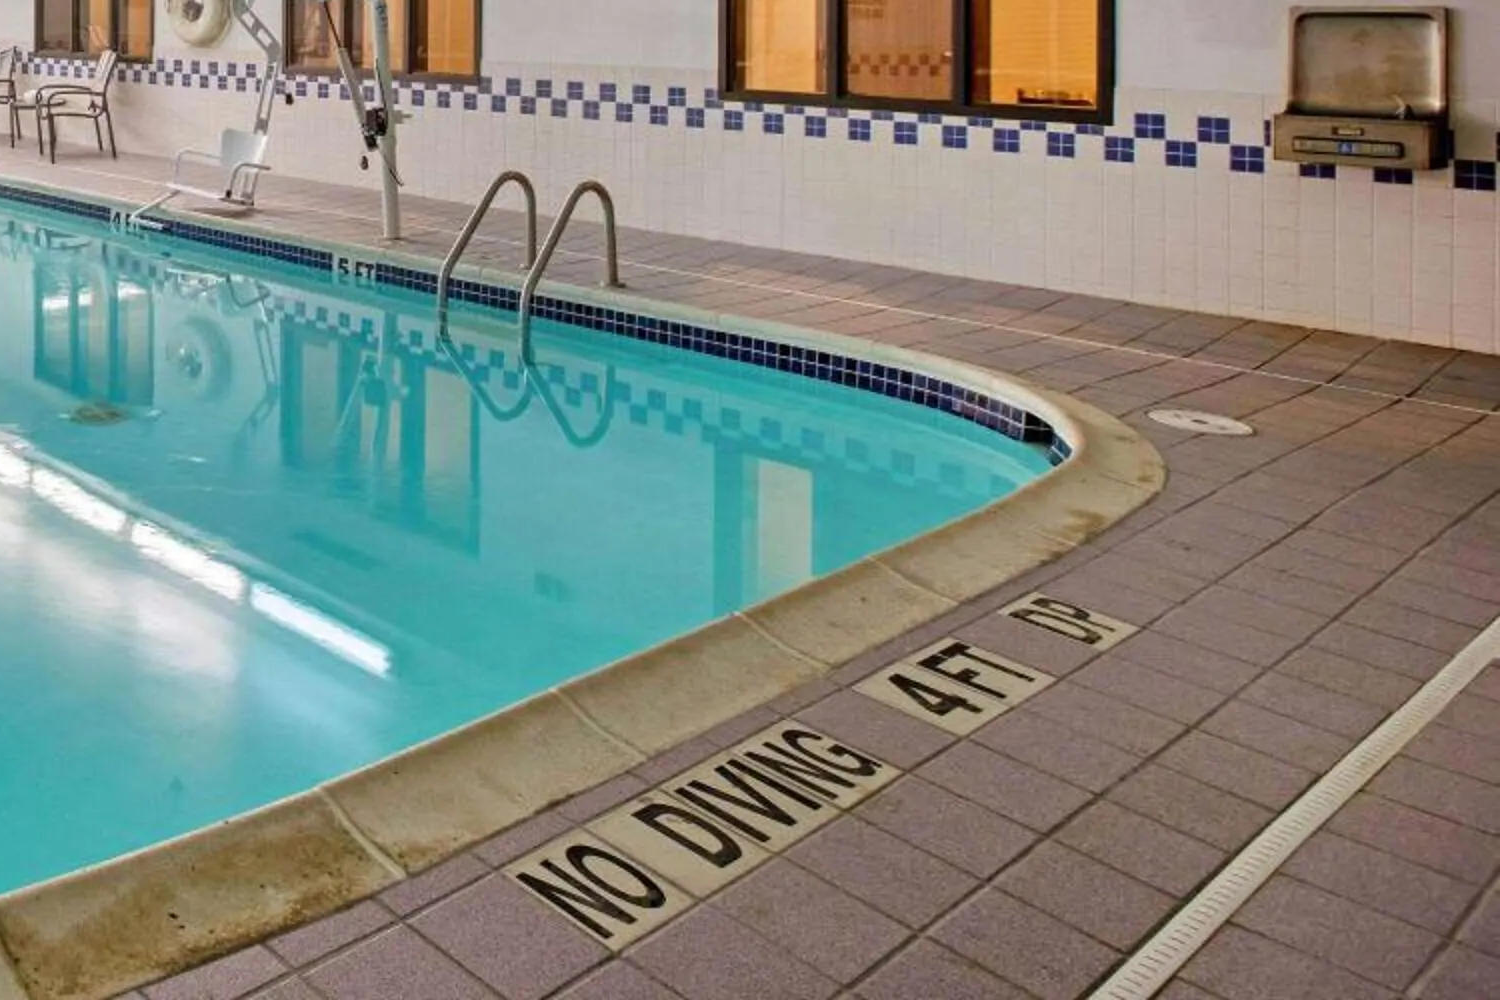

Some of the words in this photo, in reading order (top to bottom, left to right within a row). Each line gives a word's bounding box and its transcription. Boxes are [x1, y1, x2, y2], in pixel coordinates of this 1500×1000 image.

[338, 257, 349, 275] 5
[355, 261, 375, 280] FT
[515, 844, 667, 939] NO
[630, 728, 884, 868] DIVING
